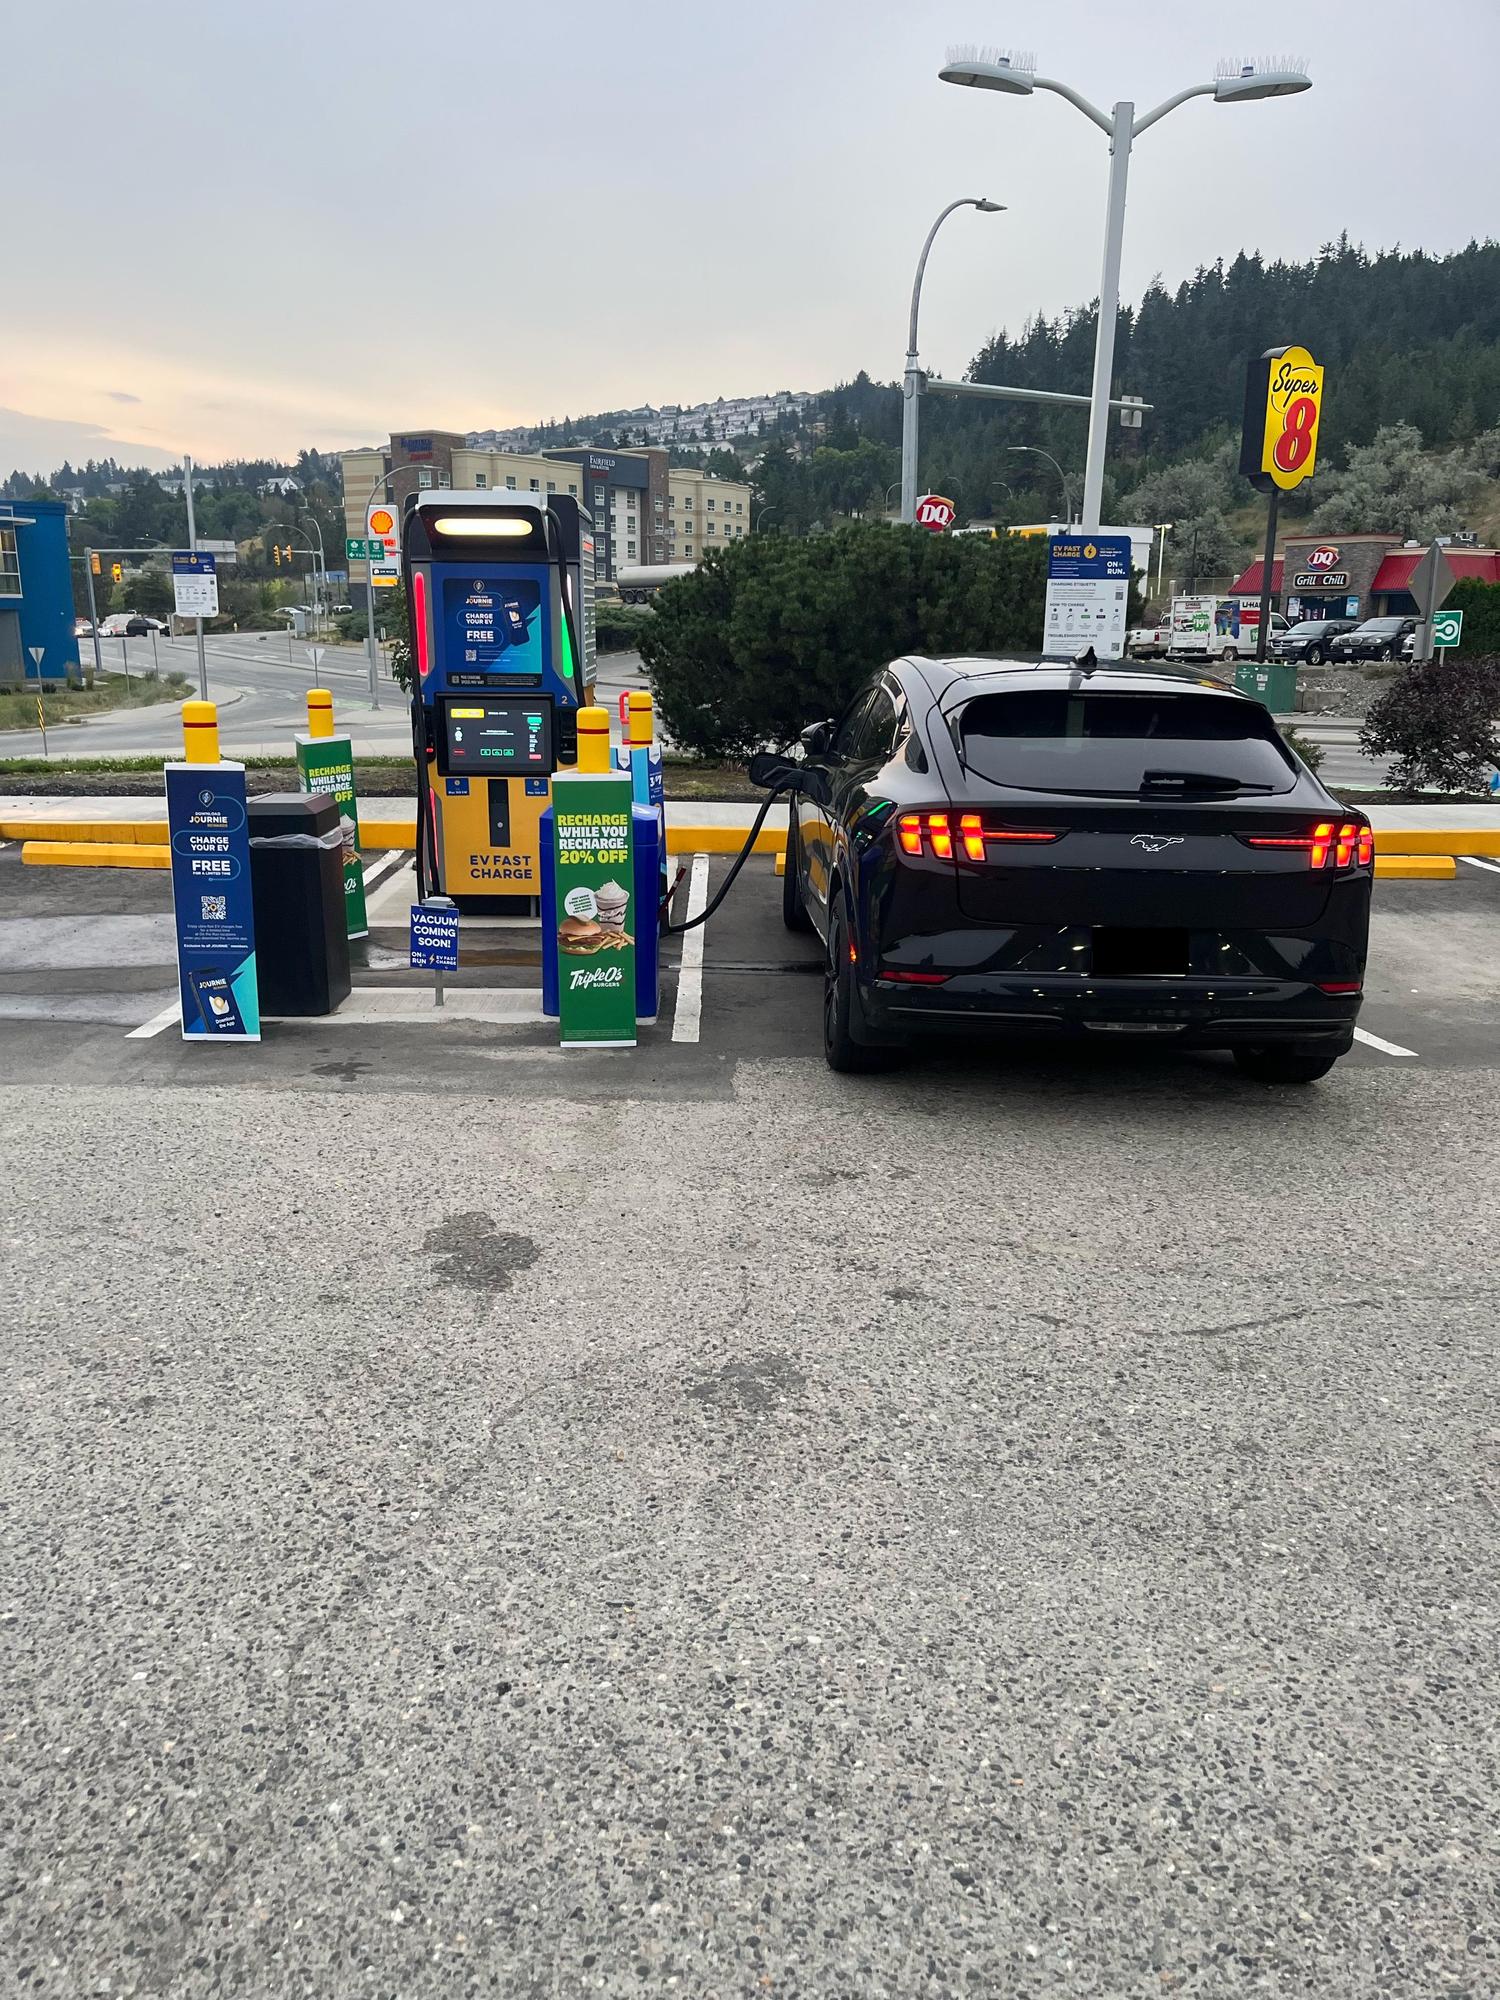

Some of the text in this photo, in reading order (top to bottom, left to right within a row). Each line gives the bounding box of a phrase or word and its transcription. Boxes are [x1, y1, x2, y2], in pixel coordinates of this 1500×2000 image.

[1272, 362, 1319, 408] Super
[1273, 397, 1317, 473] 8
[589, 455, 616, 467] FAIRFIELD
[920, 504, 949, 526] DQ
[1312, 551, 1334, 566] DQ
[1296, 576, 1316, 586] Grill
[1323, 575, 1345, 585] Chill
[467, 630, 494, 639] FREE
[562, 696, 568, 704] 2
[309, 764, 351, 777] RECHARGE
[310, 774, 334, 786] WHILE
[336, 772, 352, 782] YOU
[311, 782, 352, 793] RECHARGE.
[335, 791, 353, 802] OFF
[557, 814, 628, 826] RECHARGE
[558, 826, 628, 837] WHILE YOU
[559, 838, 628, 850] RECHARGE.
[470, 856, 531, 865] EV FAST
[560, 850, 628, 864] 20% OFF
[192, 860, 230, 871] FREE
[470, 869, 532, 879] CHARGE
[412, 914, 458, 926] VACUUM
[413, 926, 456, 937] COMING
[418, 937, 450, 948] SOON!
[199, 978, 227, 989] JOURNIE
[215, 1015, 235, 1024] Download
